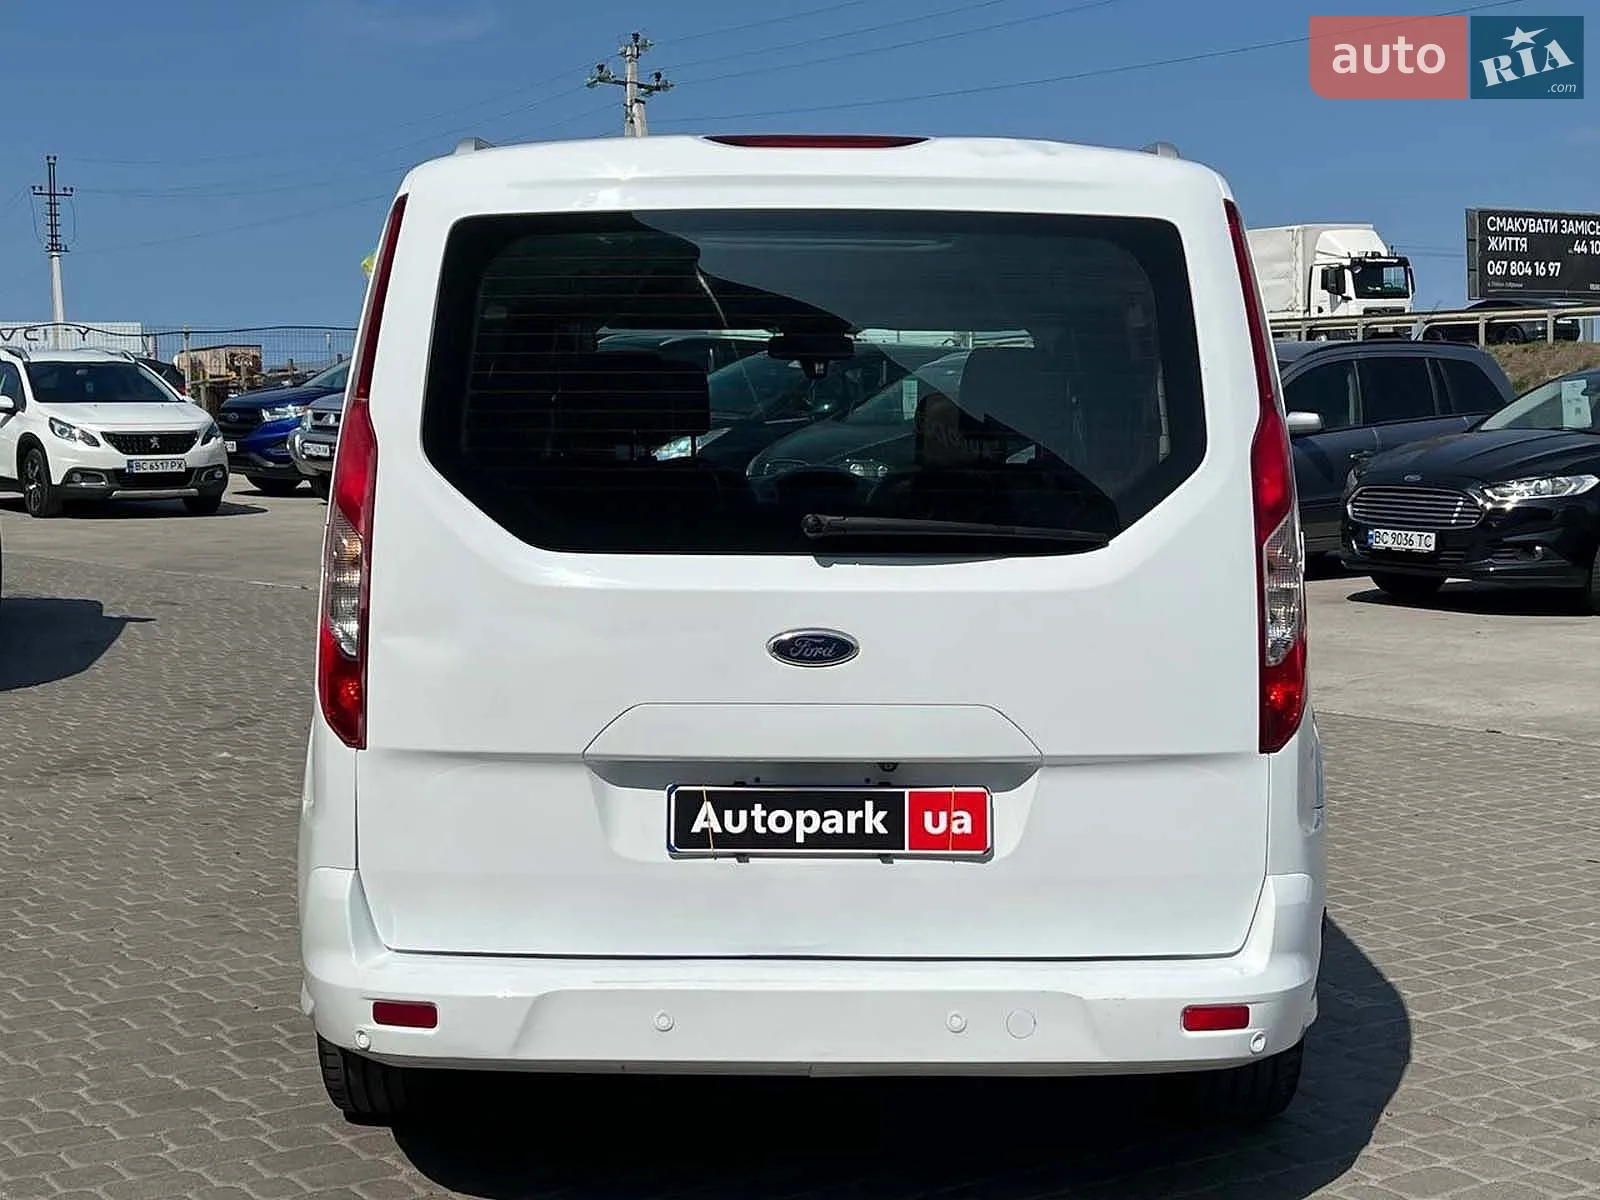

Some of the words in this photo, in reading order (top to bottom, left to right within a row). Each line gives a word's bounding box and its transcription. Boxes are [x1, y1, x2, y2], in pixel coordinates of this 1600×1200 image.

[1486, 216, 1558, 234] СМАКУВАТИ
[1487, 236, 1528, 252] ЖИТТЯ
[1573, 240, 1588, 254] 44
[1487, 260, 1508, 276] 067
[1510, 261, 1532, 276] 804
[1534, 262, 1546, 277] 16
[1548, 262, 1561, 277] 97
[1374, 531, 1388, 544] BC
[1391, 532, 1414, 547] 9036
[1417, 534, 1432, 548] TC
[790, 637, 836, 657] Ford
[690, 800, 889, 843] Autopark
[923, 809, 972, 835] ua
